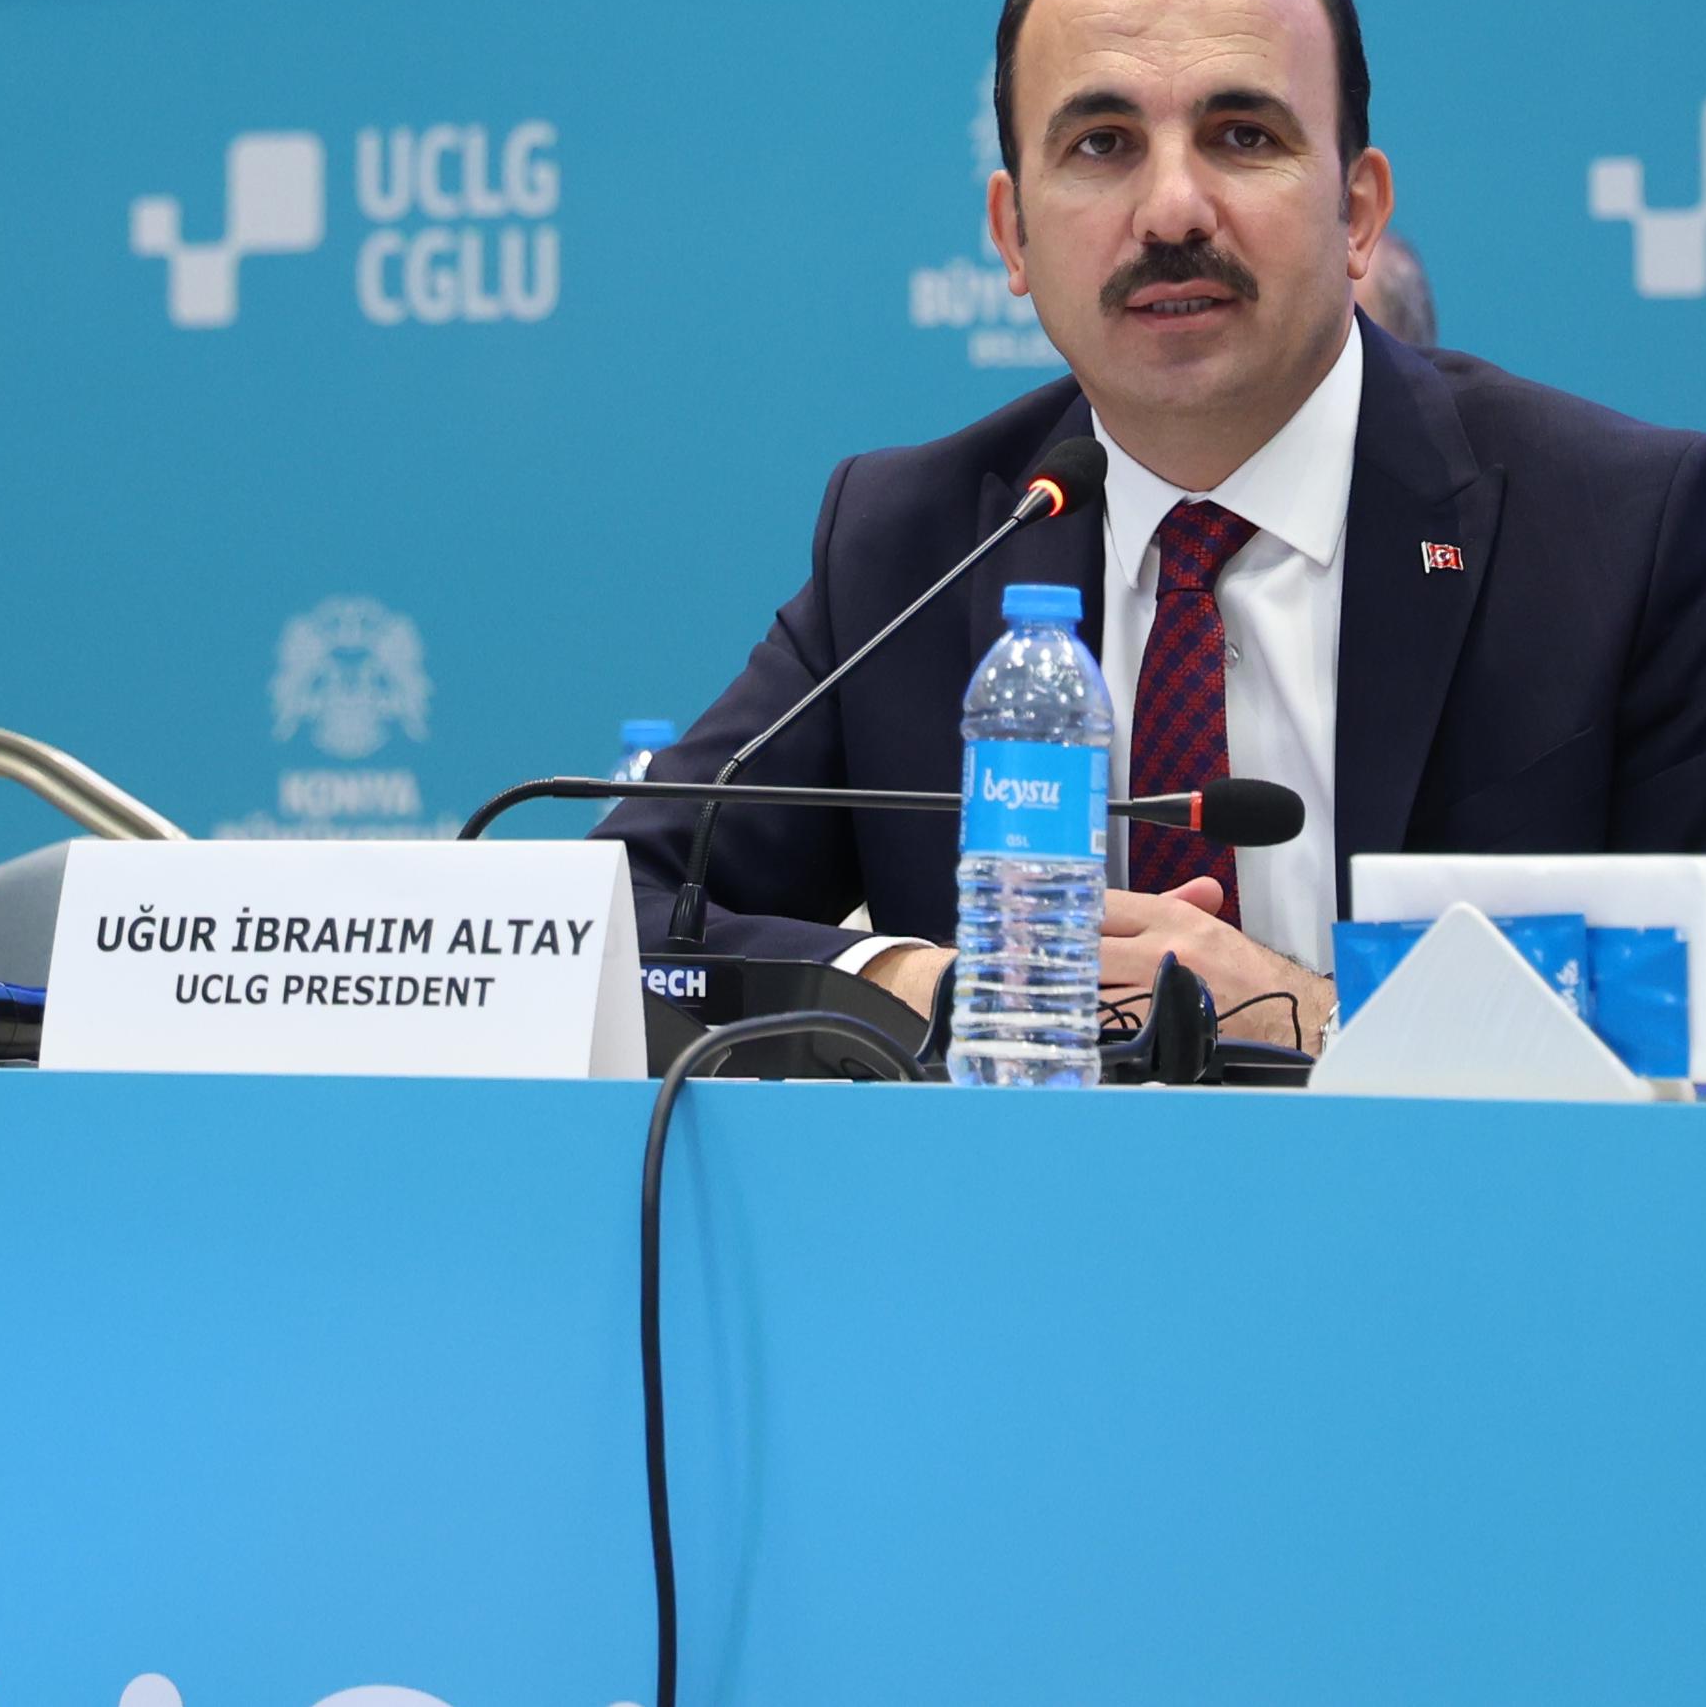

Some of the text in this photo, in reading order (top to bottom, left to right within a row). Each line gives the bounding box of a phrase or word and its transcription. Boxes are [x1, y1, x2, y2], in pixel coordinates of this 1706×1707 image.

[355, 120, 561, 221] UCLG
[355, 227, 561, 324] CGLU
[984, 768, 1060, 809] beysu
[96, 905, 594, 956] UĞUR İBRAHIM ALTAY
[175, 974, 495, 1007] UCLG PRESIDENT
